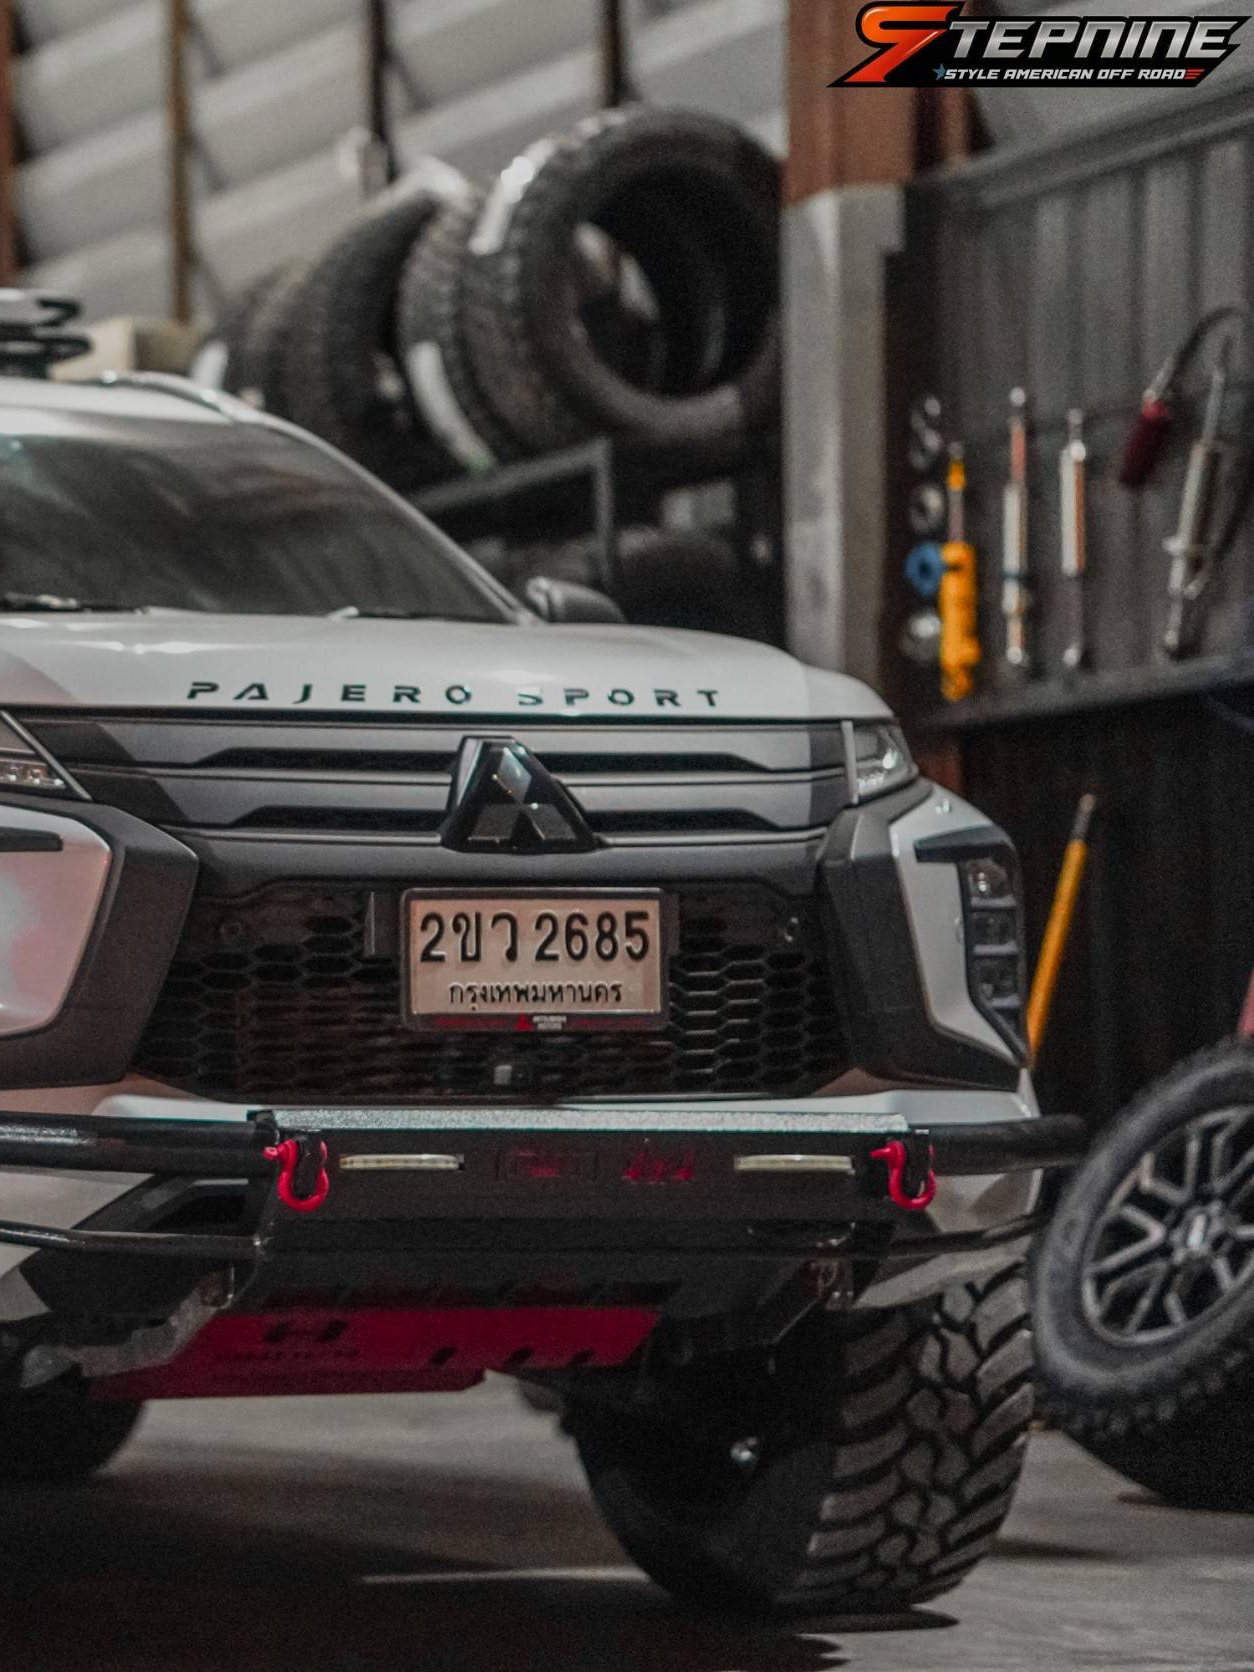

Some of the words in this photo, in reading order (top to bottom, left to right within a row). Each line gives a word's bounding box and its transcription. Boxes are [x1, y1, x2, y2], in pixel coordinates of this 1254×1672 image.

[186, 681, 472, 705] PAJERO
[517, 685, 719, 708] SPORT
[420, 910, 519, 963] 2ขว
[534, 910, 650, 963] 2685
[449, 982, 623, 1011] กรุงเทพมหานคร
